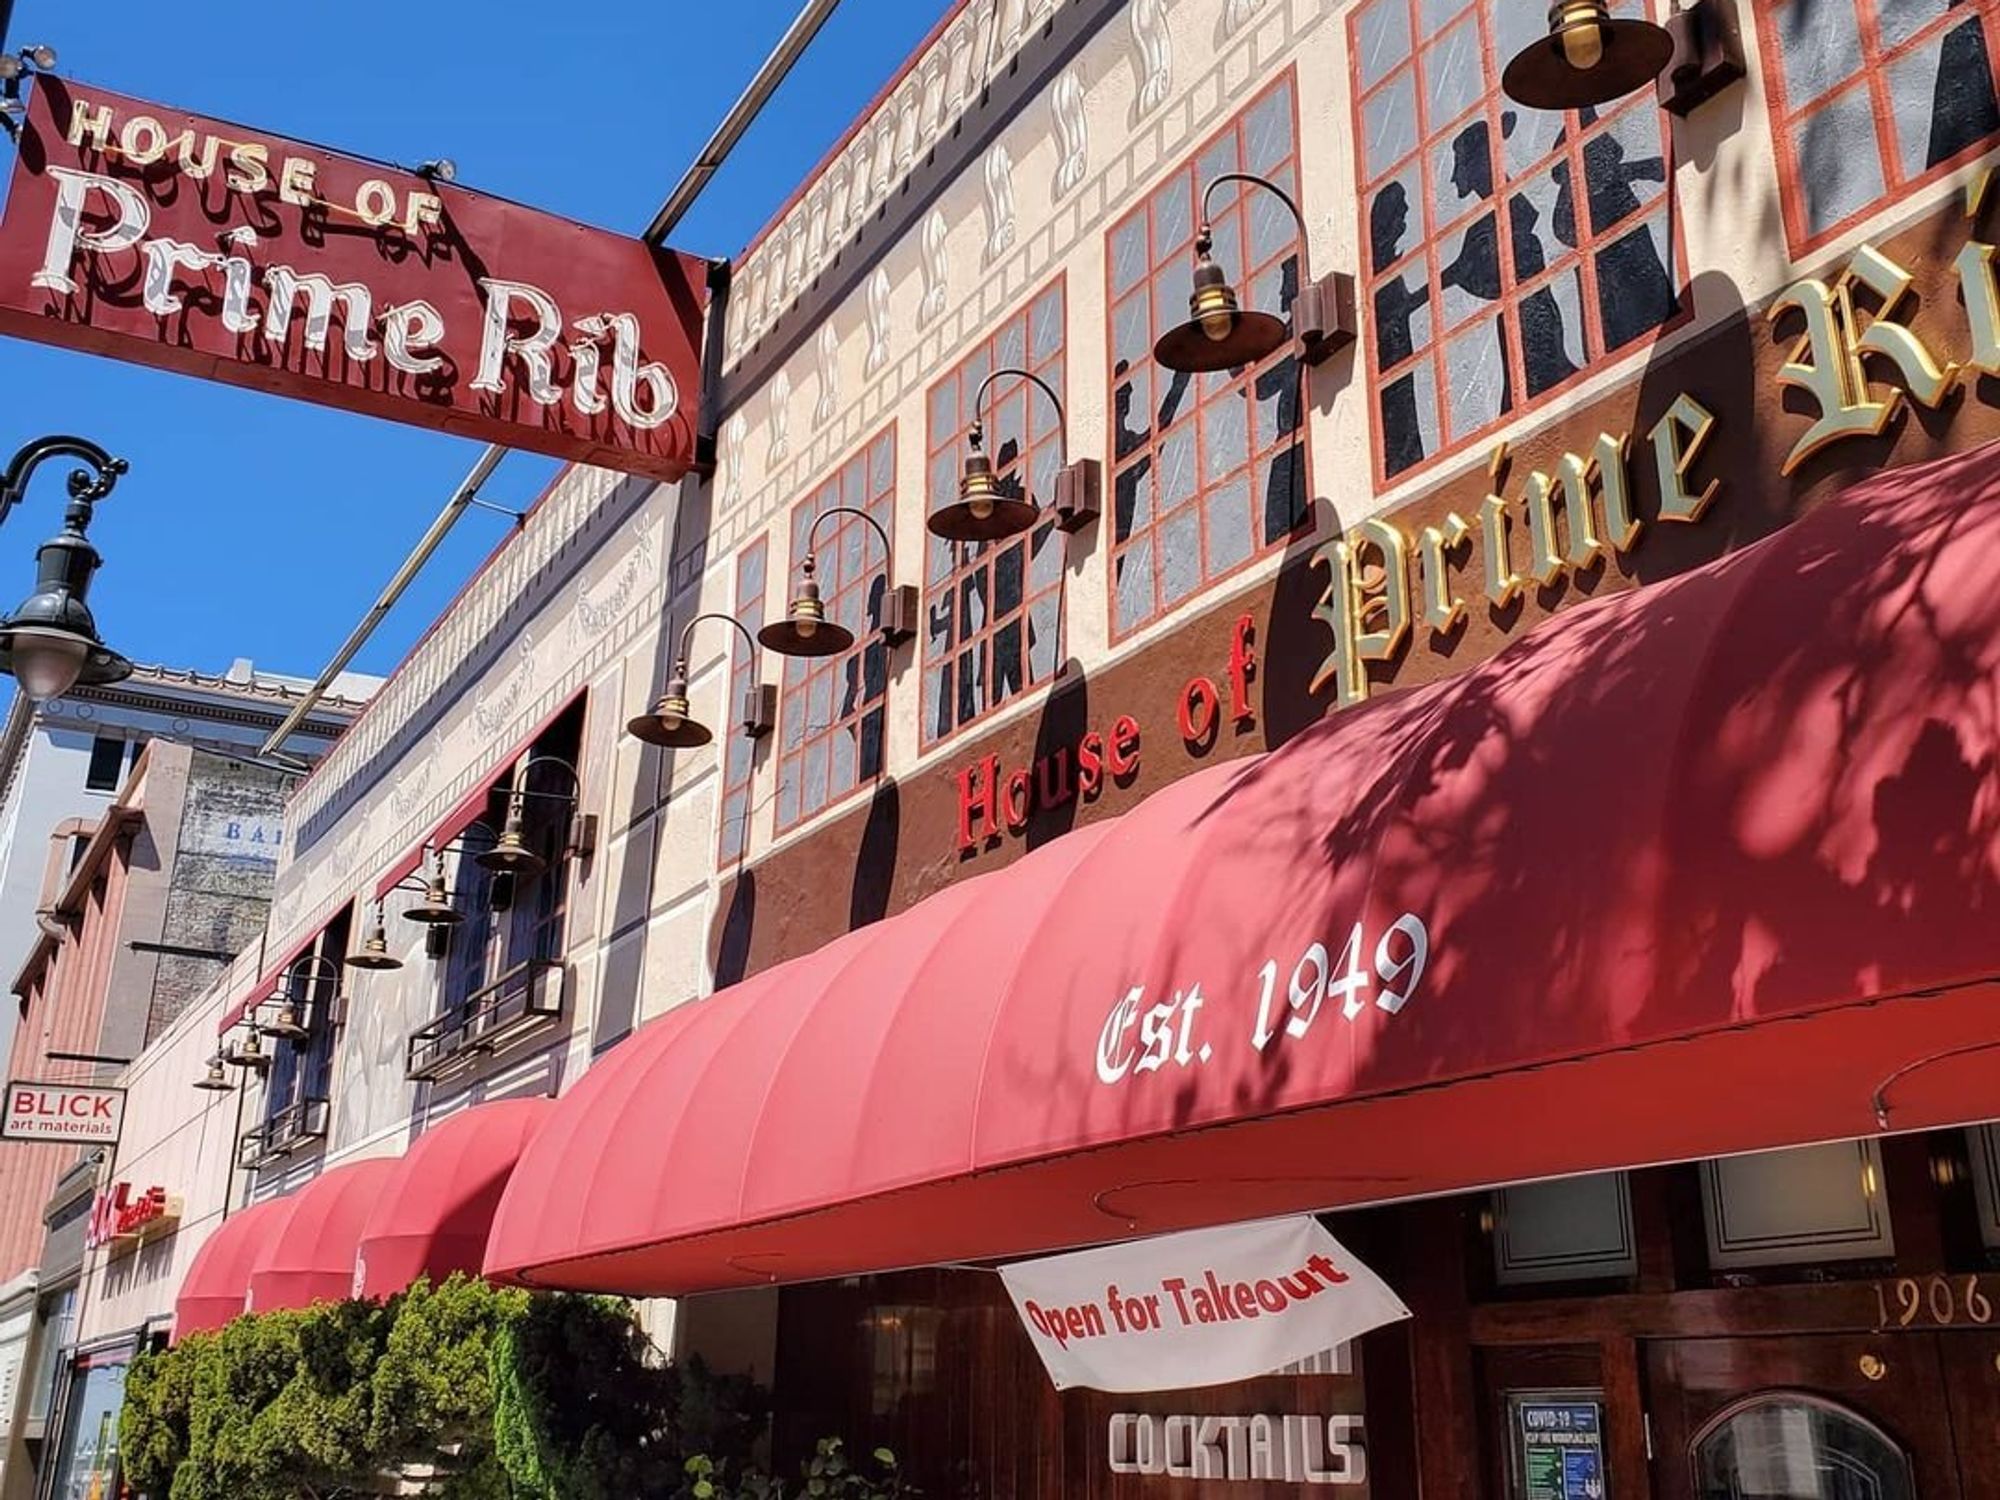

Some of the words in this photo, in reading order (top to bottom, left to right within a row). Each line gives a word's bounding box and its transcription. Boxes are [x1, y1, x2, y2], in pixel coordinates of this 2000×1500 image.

[68, 99, 317, 205] HOUSE
[355, 178, 441, 235] OF
[31, 165, 444, 374] Prime
[469, 277, 678, 429] Rib
[956, 714, 1140, 848] House
[1177, 615, 1254, 739] of
[1309, 393, 1720, 706] Prime
[1096, 981, 1212, 1084] Est.
[1251, 912, 1429, 1052] 1949
[11, 1120, 33, 1131] art
[39, 1120, 113, 1135] materials
[14, 1092, 117, 1118] BLICK
[1025, 1299, 1105, 1351] Open
[1109, 1284, 1161, 1333] for
[1162, 1254, 1350, 1326] Takeout
[1872, 1274, 1992, 1327] 1906
[1108, 1412, 1366, 1484] COCKTAILS
[1527, 1411, 1570, 1428] COVID-19
